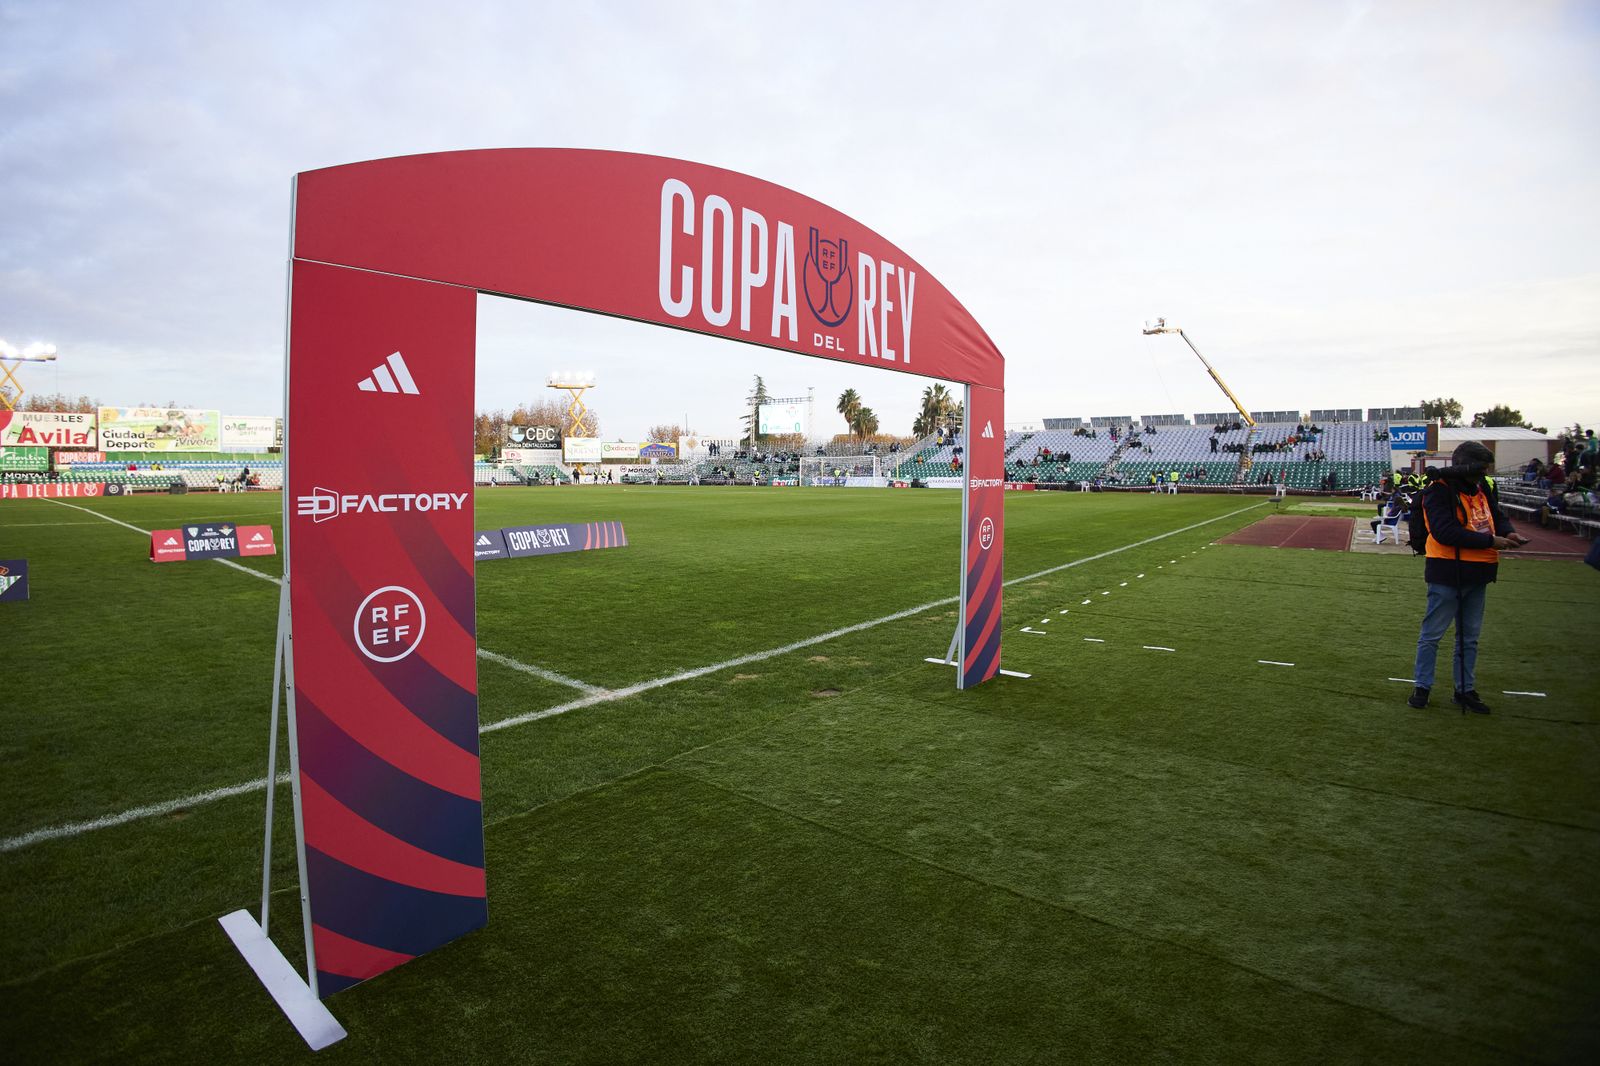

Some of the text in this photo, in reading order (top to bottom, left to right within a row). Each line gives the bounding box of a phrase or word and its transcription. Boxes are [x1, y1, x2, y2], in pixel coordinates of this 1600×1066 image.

[658, 177, 916, 364] COPA REY
[813, 333, 845, 353] DEL
[17, 422, 88, 444] Ávila
[102, 429, 146, 439] Ciudad
[525, 427, 556, 441] CDC
[106, 439, 156, 450] Deporte
[27, 483, 49, 497] DEL
[56, 482, 79, 497] REY
[969, 477, 1003, 489] 3DFACTORY
[297, 489, 468, 519] 3DFACTORY
[187, 538, 210, 552] COPA
[220, 537, 235, 550] REY
[508, 527, 571, 551] COPA REY
[371, 603, 410, 624] RF
[371, 624, 410, 646] EF
